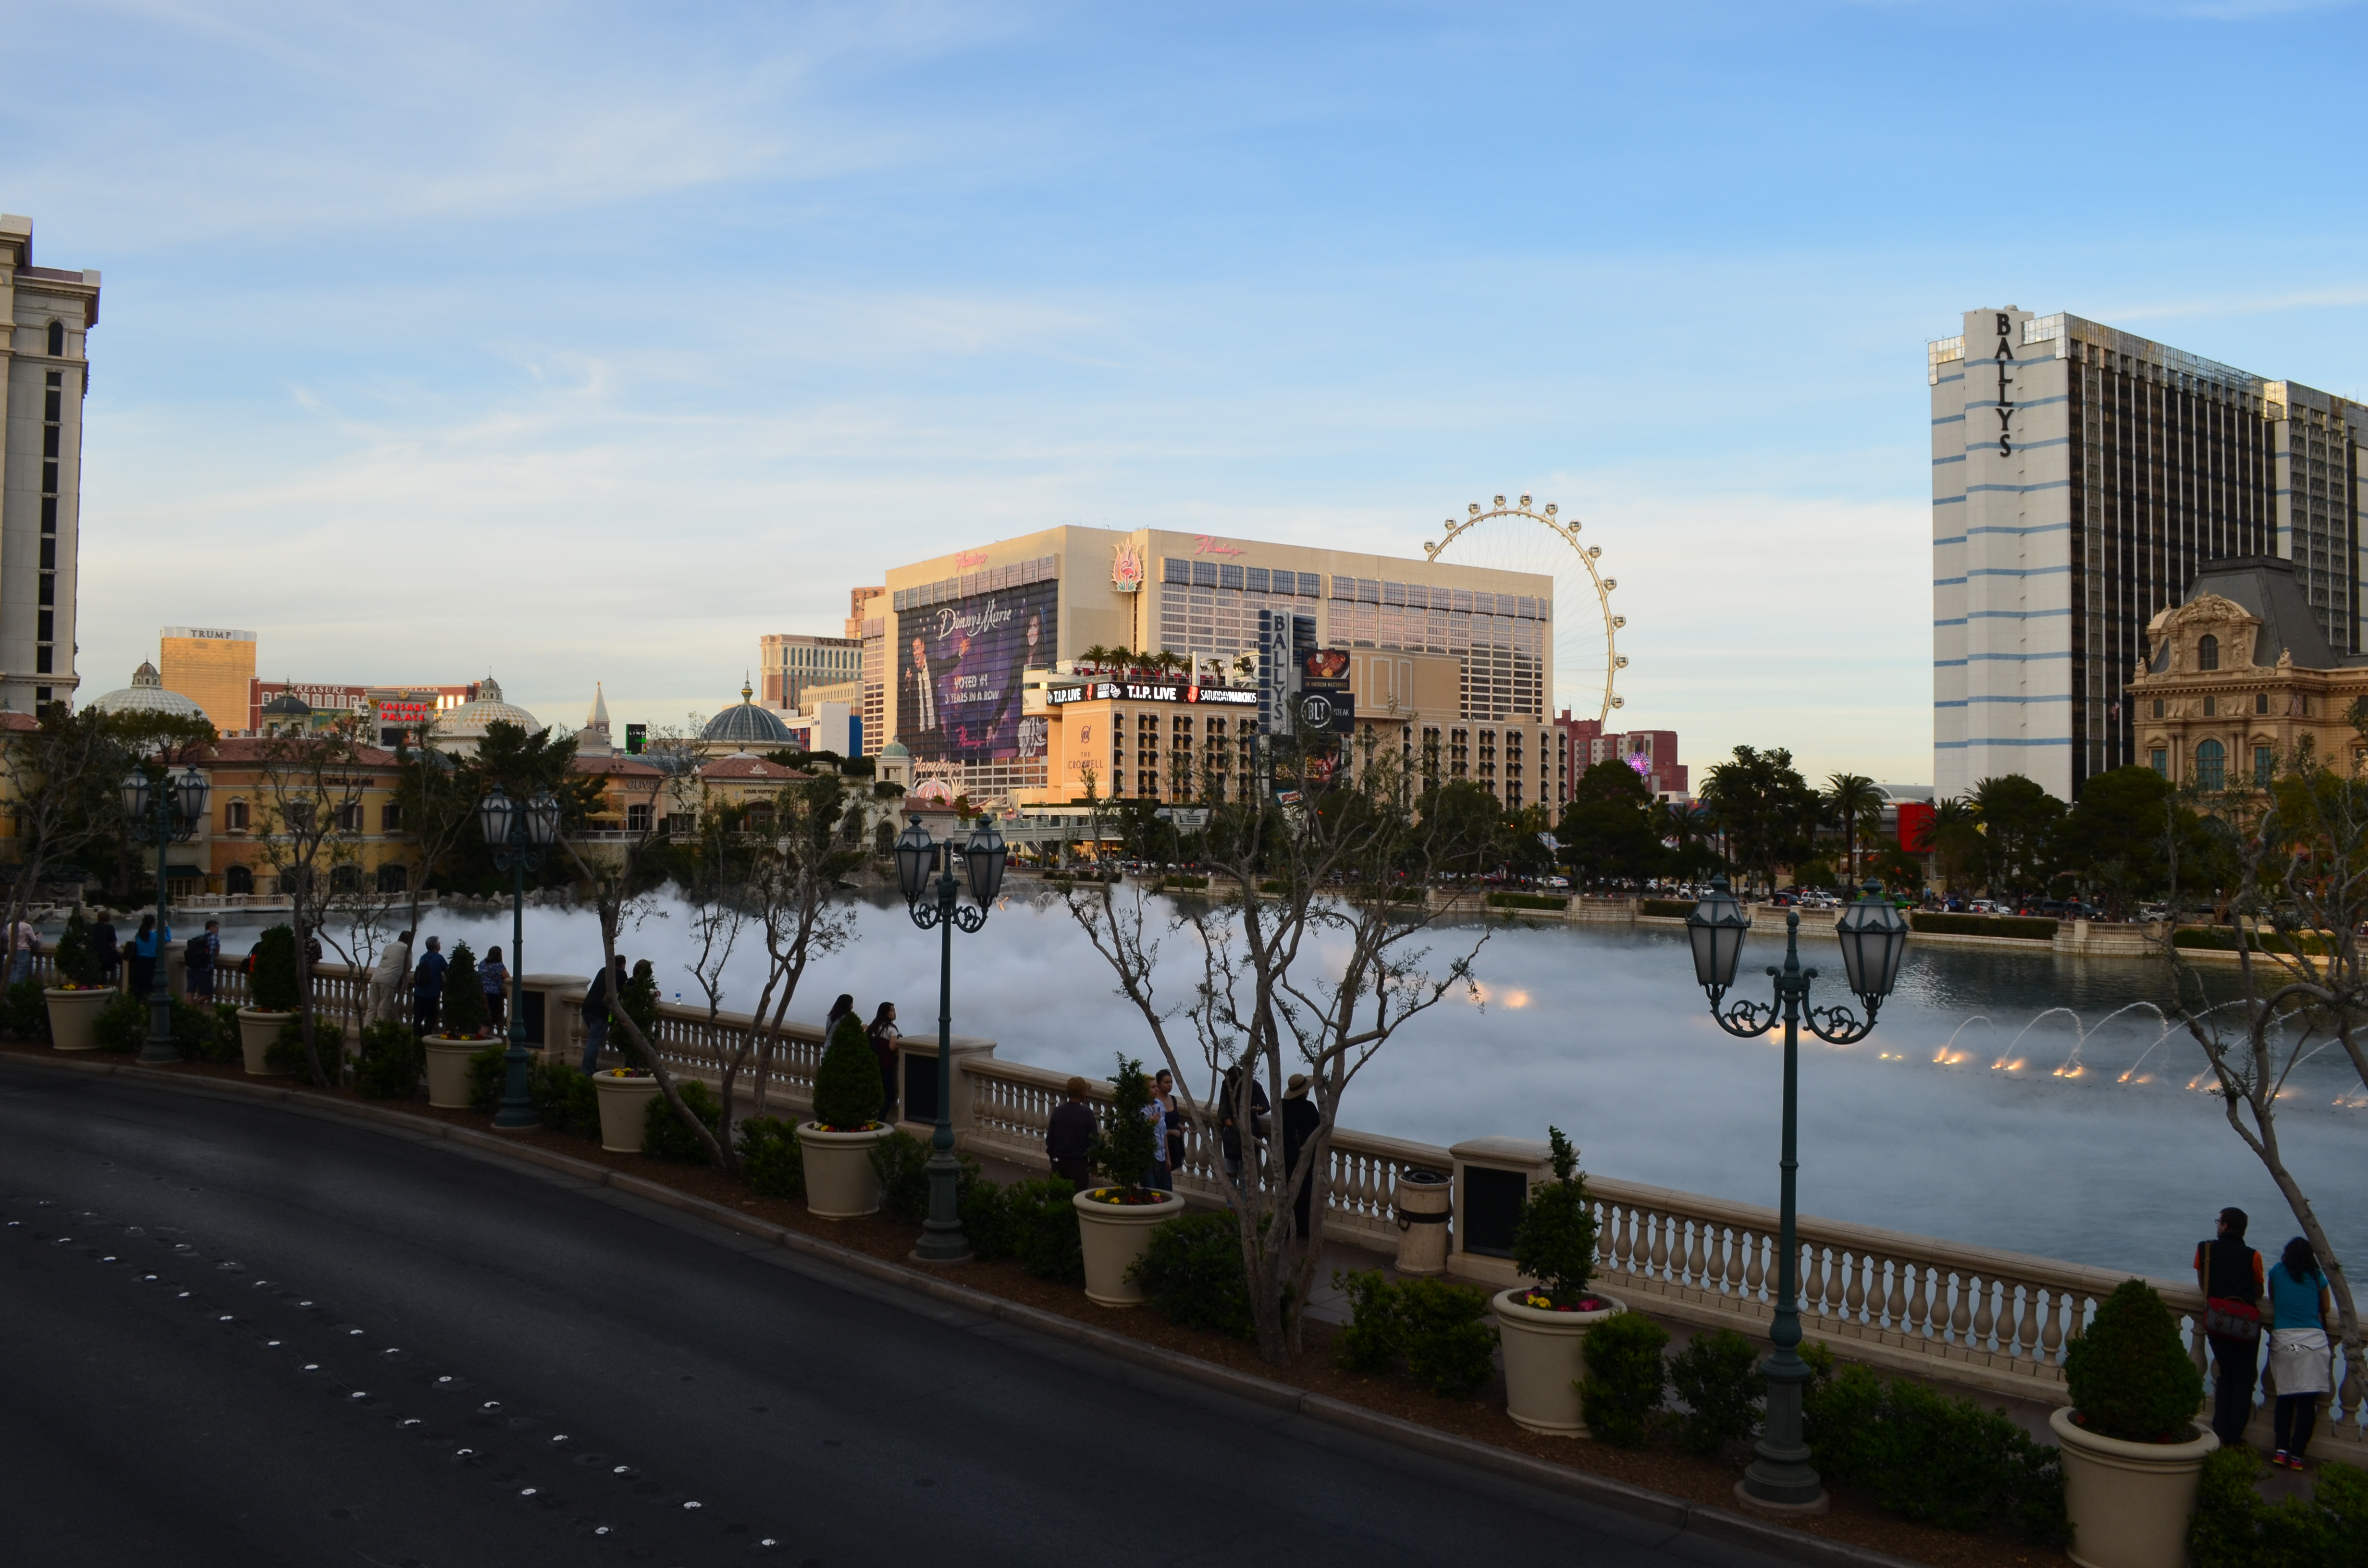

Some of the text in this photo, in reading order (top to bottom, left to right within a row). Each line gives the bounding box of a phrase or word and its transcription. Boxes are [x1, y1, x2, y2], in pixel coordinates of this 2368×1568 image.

[1994, 313, 2015, 457] BALLYS
[1194, 534, 1246, 560] Flamingo
[955, 551, 988, 573] Flamingo
[936, 608, 977, 641] Donny
[973, 599, 1012, 636] Marie
[191, 630, 232, 639] TRUMP
[1272, 615, 1286, 720] BALLYS
[954, 674, 988, 689] VOTED #1
[945, 689, 999, 705] 3 YEARS IN A ROW
[1053, 689, 1067, 703] T.I.P.
[1068, 688, 1081, 701] LIVE
[1127, 685, 1151, 699] T.I.P.
[1154, 686, 1176, 700] LIVE
[379, 702, 427, 712] CAESARS
[1308, 702, 1325, 720] BLT
[381, 712, 424, 722] PALACE
[1068, 760, 1103, 769] CROMWELL
